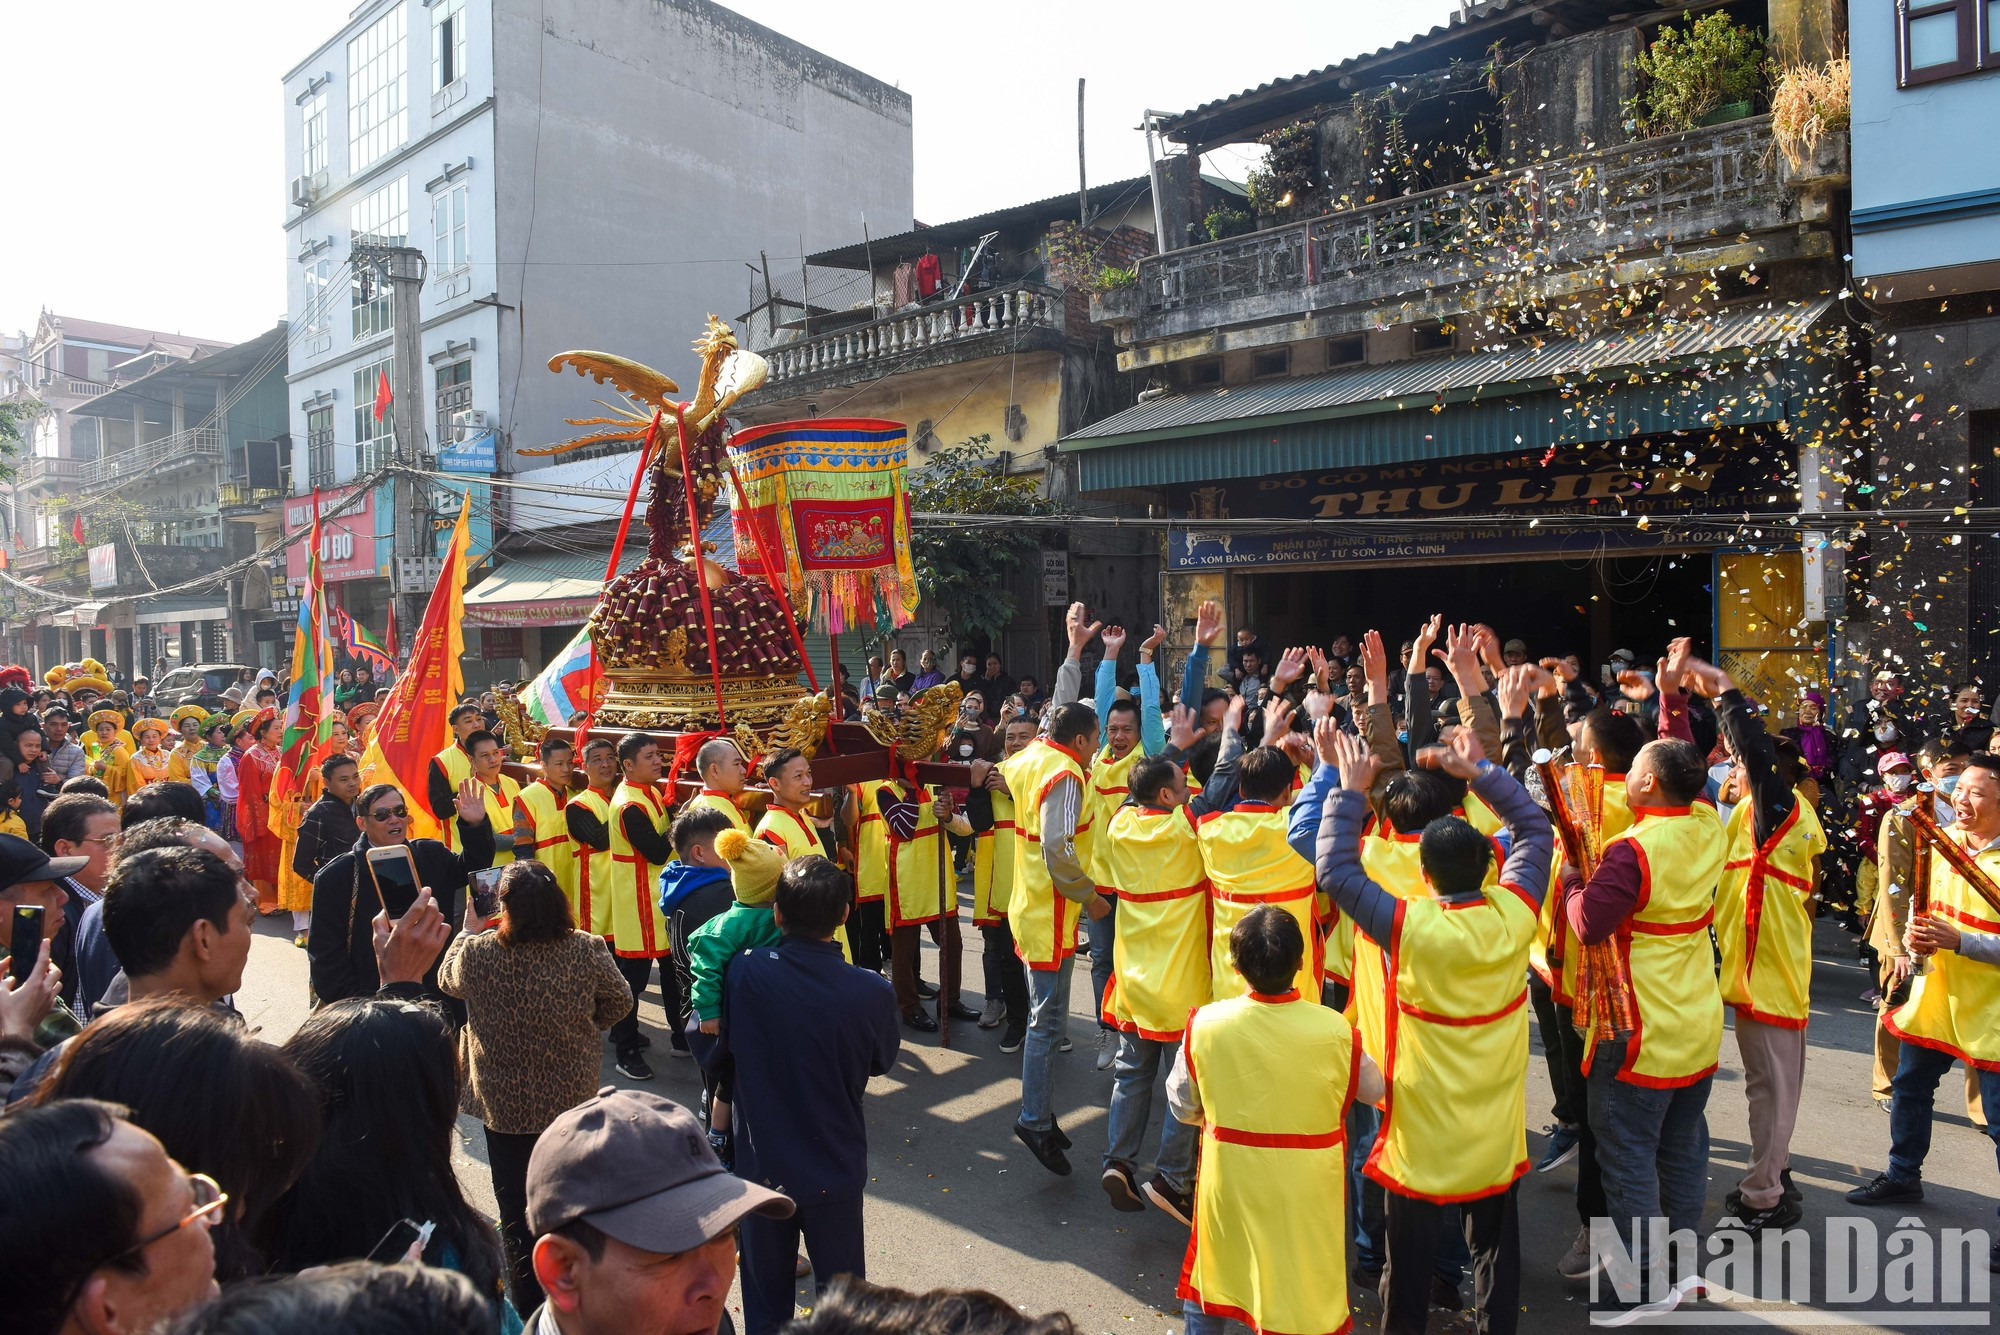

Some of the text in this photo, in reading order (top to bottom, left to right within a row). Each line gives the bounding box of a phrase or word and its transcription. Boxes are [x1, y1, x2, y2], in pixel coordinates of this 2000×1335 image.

[1379, 463, 1428, 481] MỸ
[1555, 445, 1649, 465] CAO
[1310, 462, 1726, 518] THU LIÊN
[1200, 552, 1223, 565] XÓM
[1352, 547, 1377, 558] SƠN
[1416, 544, 1446, 556] NINH
[482, 608, 497, 622] MỸ
[529, 606, 551, 620] CAO
